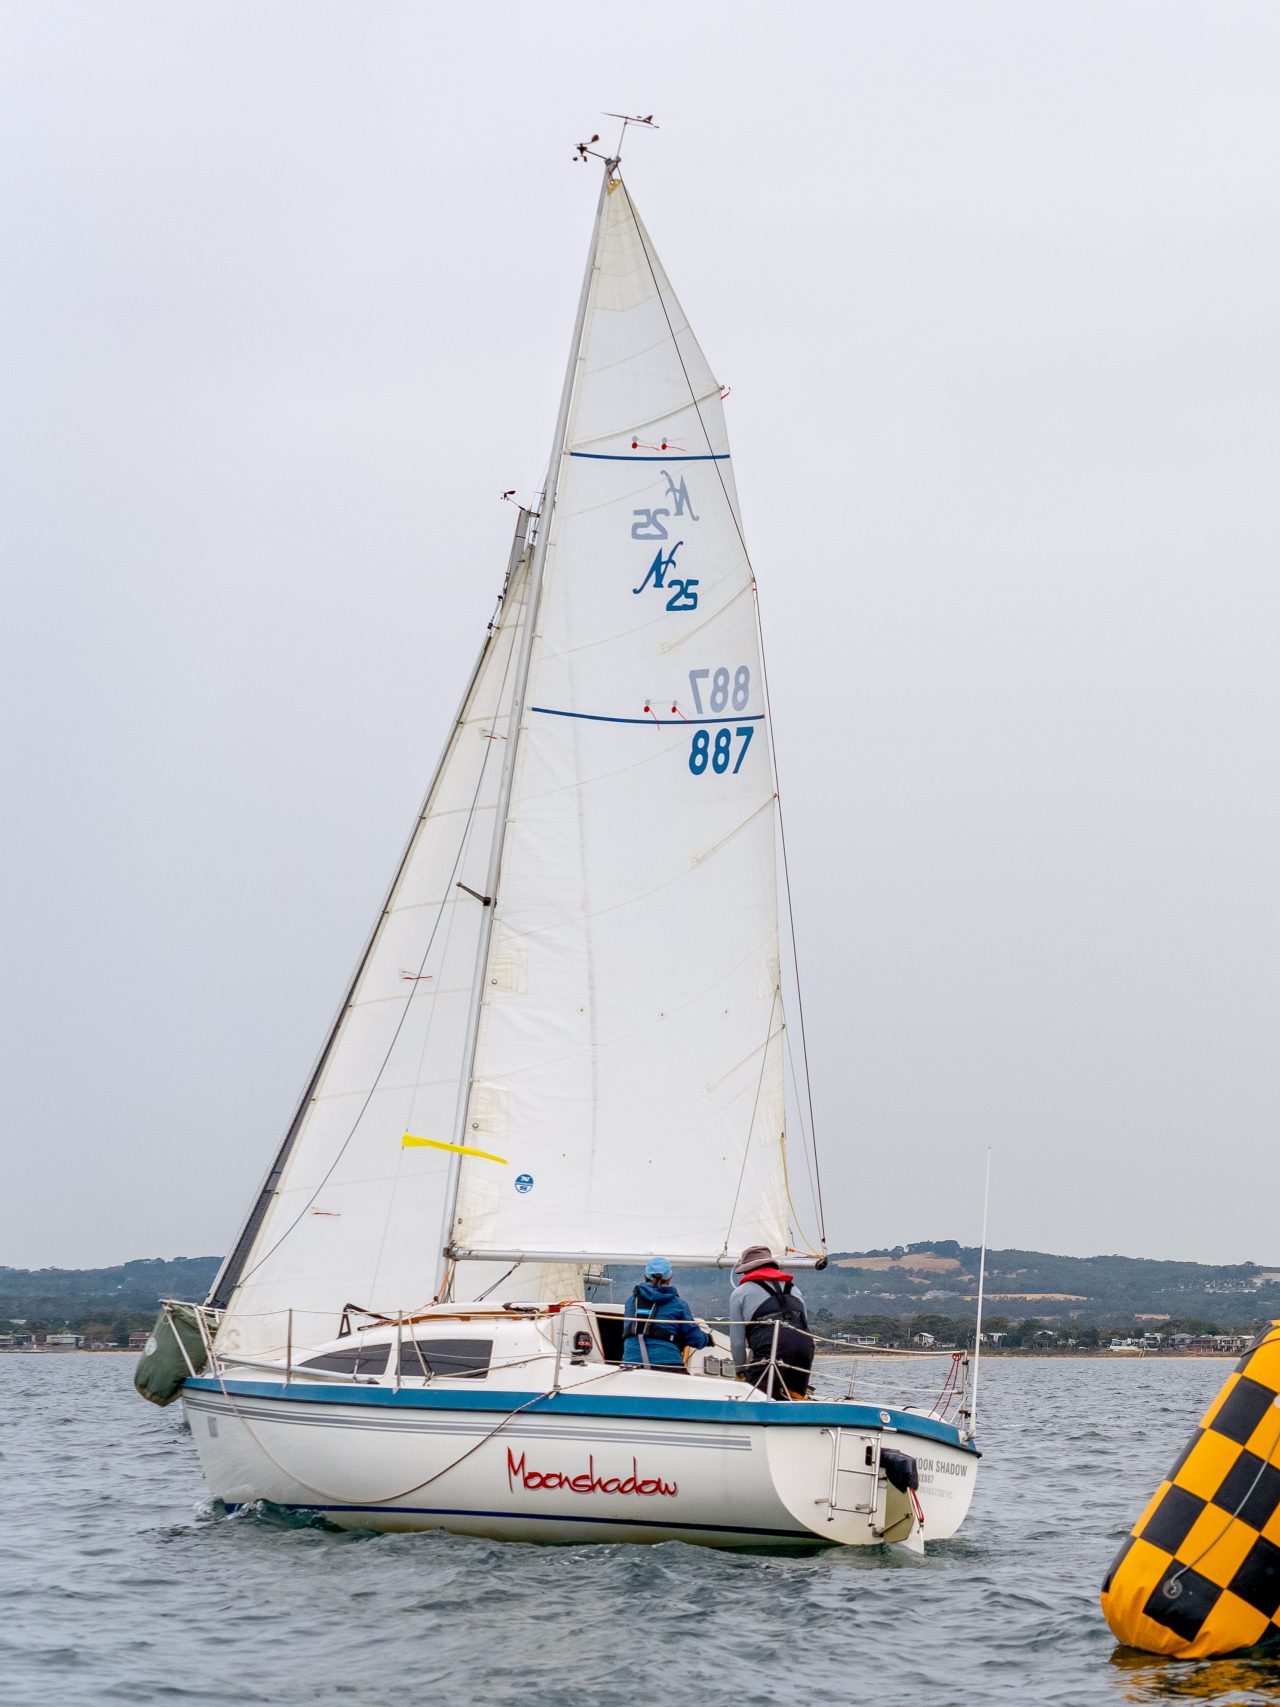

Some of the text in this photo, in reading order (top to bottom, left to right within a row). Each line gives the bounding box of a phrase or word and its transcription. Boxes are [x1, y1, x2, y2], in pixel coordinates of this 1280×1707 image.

[666, 579, 699, 611] 25
[688, 726, 754, 775] 887
[507, 1446, 678, 1497] Moonshadow
[916, 1457, 968, 1477] OON SHADOW
